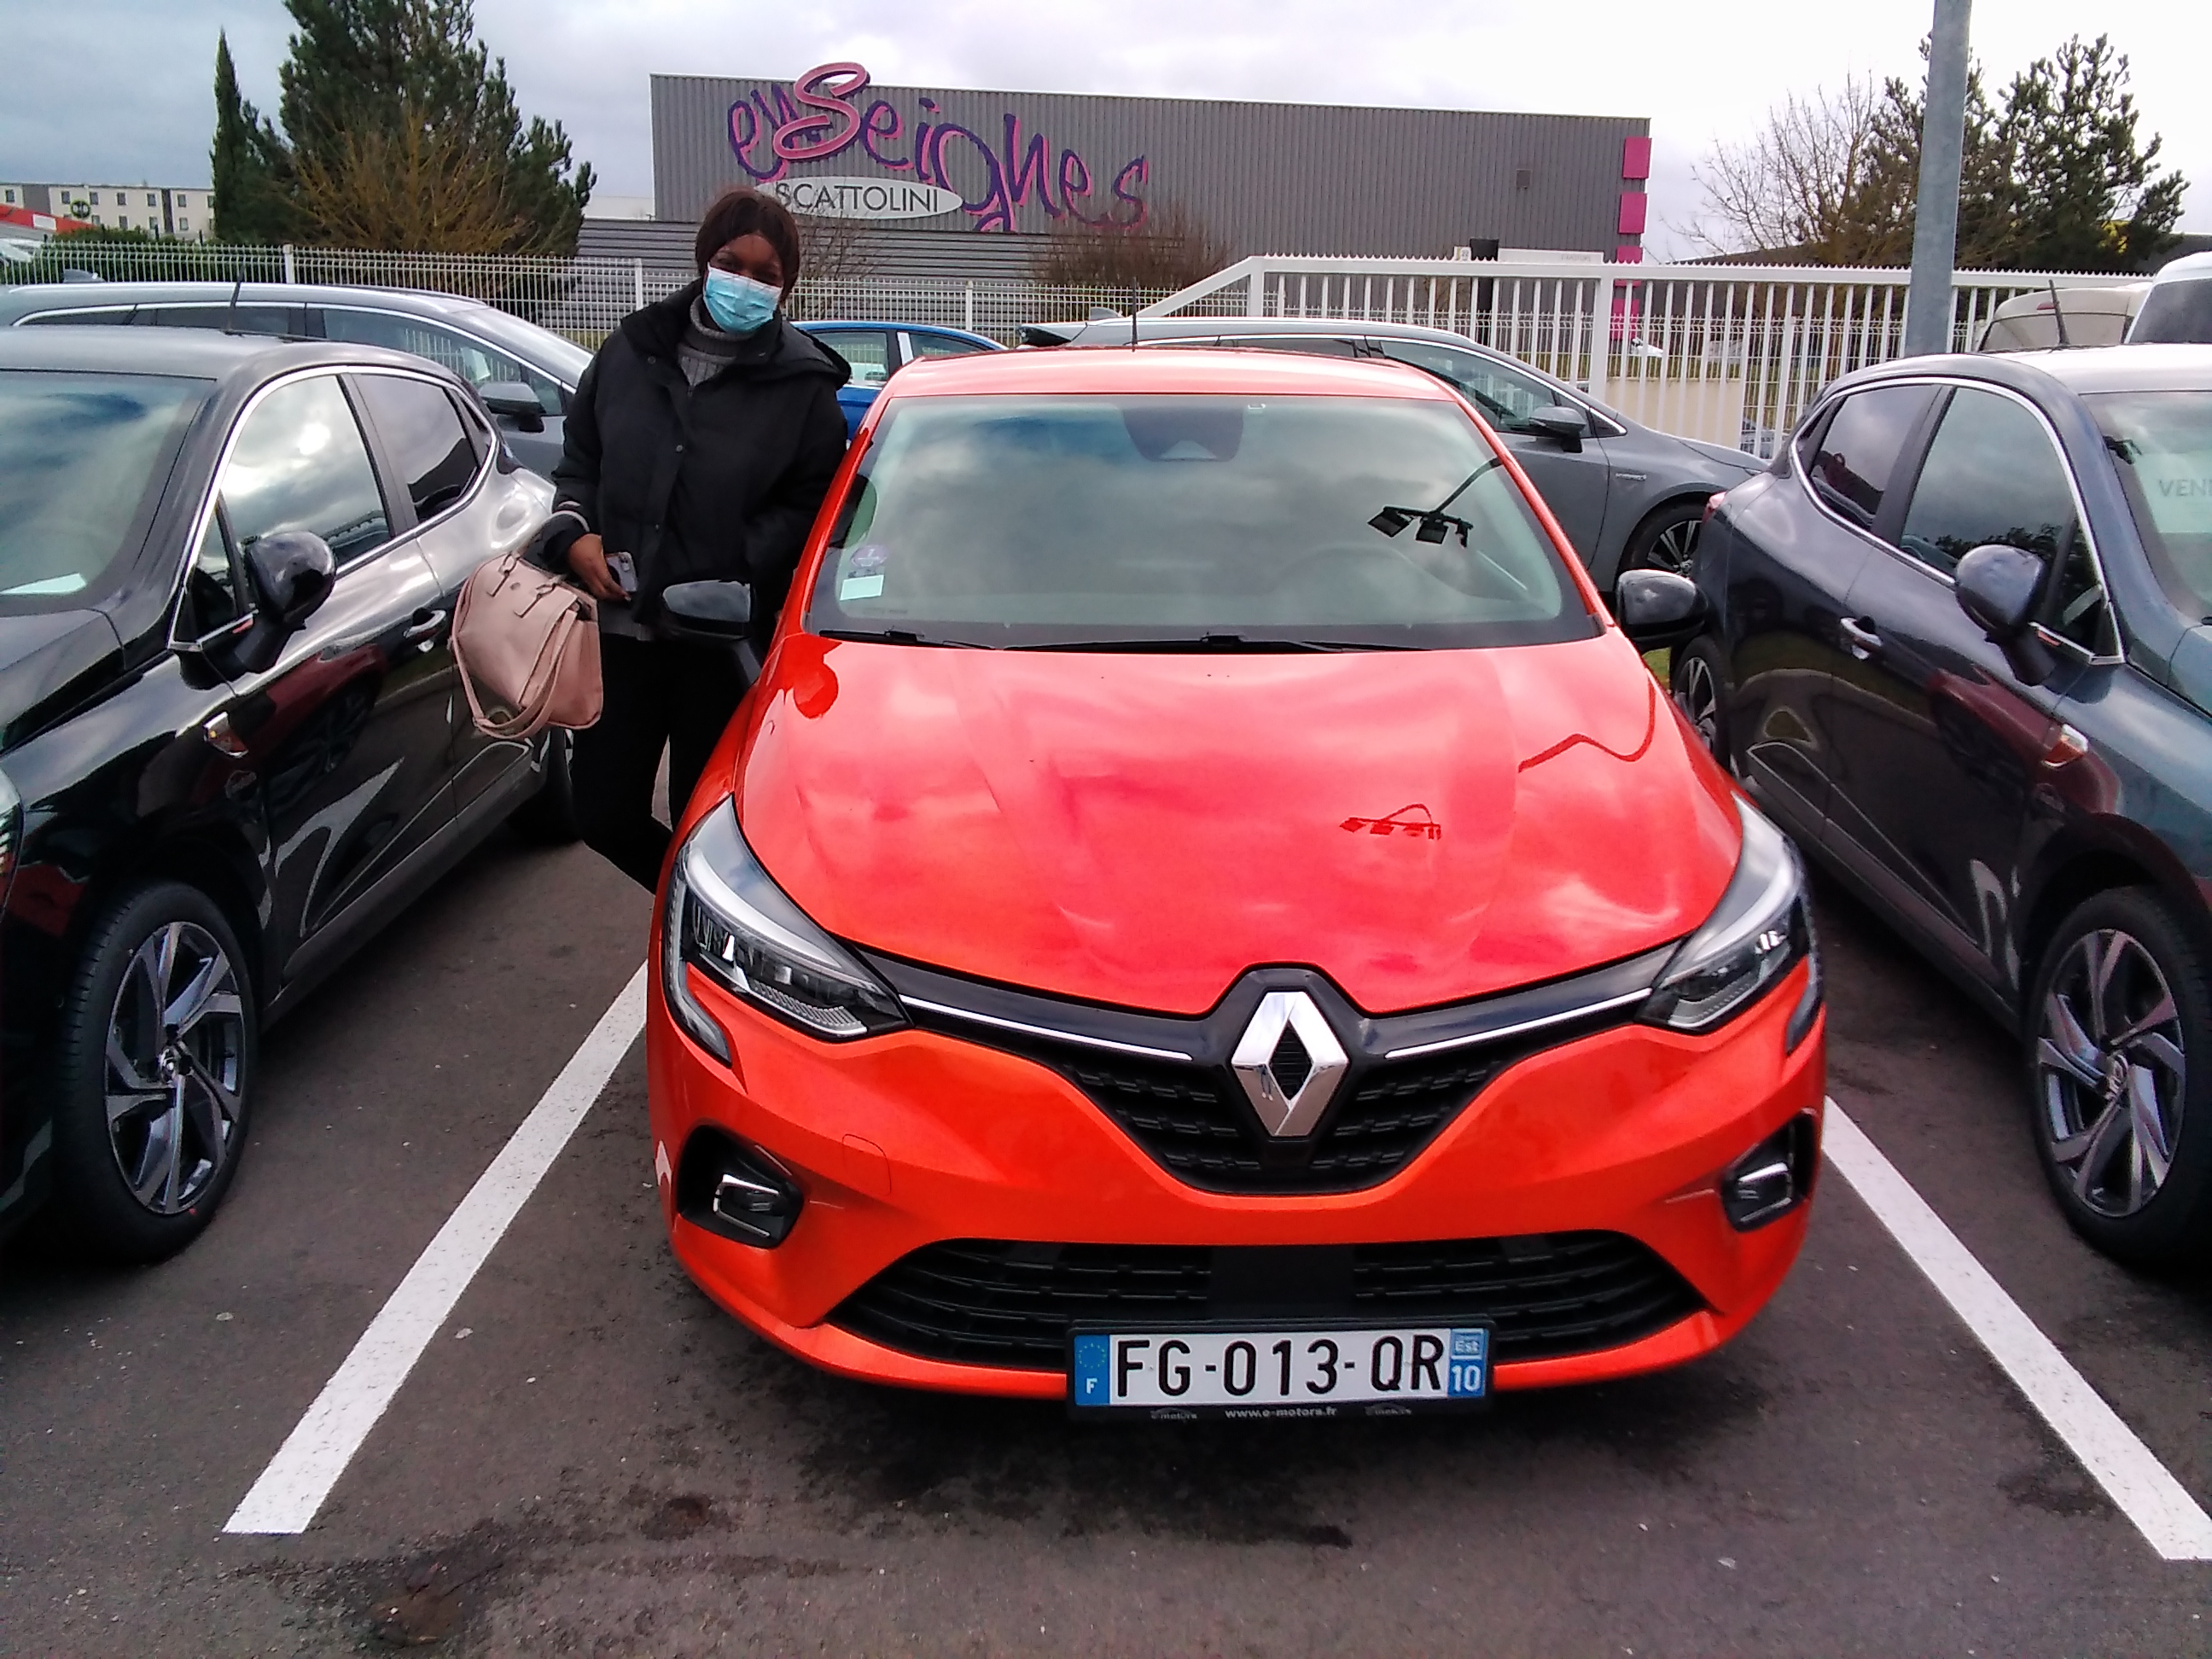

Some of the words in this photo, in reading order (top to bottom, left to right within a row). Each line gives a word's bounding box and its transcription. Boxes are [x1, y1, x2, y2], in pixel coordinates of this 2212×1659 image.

[775, 180, 940, 212] SCATTOLINI
[2158, 479, 2212, 497] VEN
[1116, 1335, 1444, 1397] FG-013-QR
[1451, 1365, 1481, 1393] 10
[1086, 1377, 1097, 1394] F
